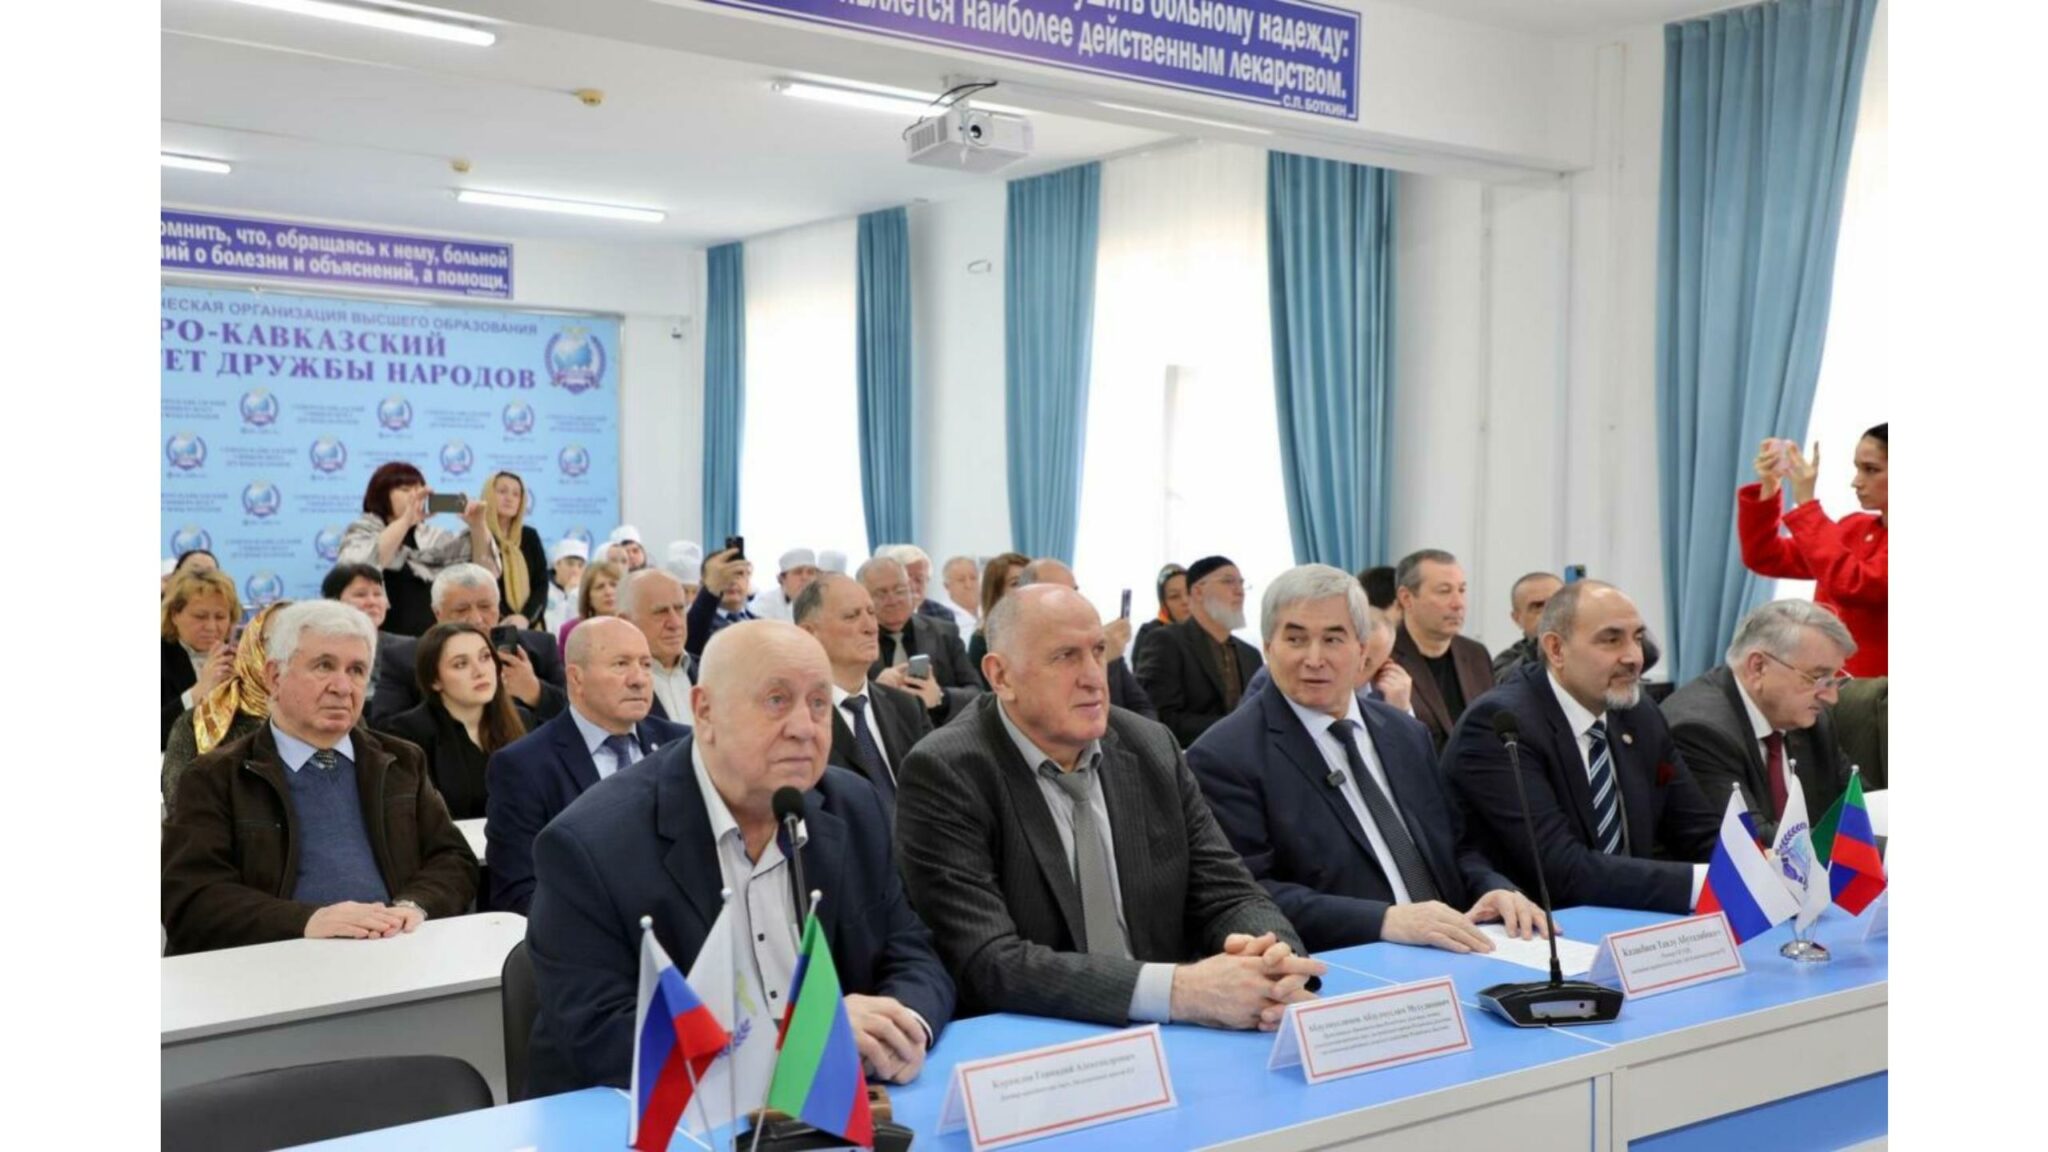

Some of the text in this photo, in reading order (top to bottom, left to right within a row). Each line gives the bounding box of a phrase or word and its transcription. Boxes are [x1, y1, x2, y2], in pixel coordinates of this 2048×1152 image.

[963, 0, 1073, 47] наиболее
[1078, 14, 1225, 76] действенным
[1229, 49, 1347, 98] лекарством.
[1150, 0, 1349, 62] больному надежду:
[195, 247, 207, 263] о
[211, 244, 288, 271] болезни
[294, 256, 305, 272] и
[309, 254, 420, 286] объяснений,
[423, 268, 434, 284] а
[437, 269, 508, 290] помощи.
[236, 228, 272, 249] что,
[276, 228, 375, 257] обращаясь
[379, 242, 391, 258] к
[394, 243, 440, 266] нему,
[443, 245, 508, 269] больной
[161, 318, 446, 357] РО-КАВКАЗСКИЙ
[229, 302, 347, 322] ОРГАНИЗАЦИЯ
[351, 312, 429, 329] ВЫСШЕГО
[433, 317, 538, 336] ОБРАЗОВАНИЯ
[216, 351, 374, 381] ДРУЖБЫ
[388, 361, 536, 390] НАРОДОВ
